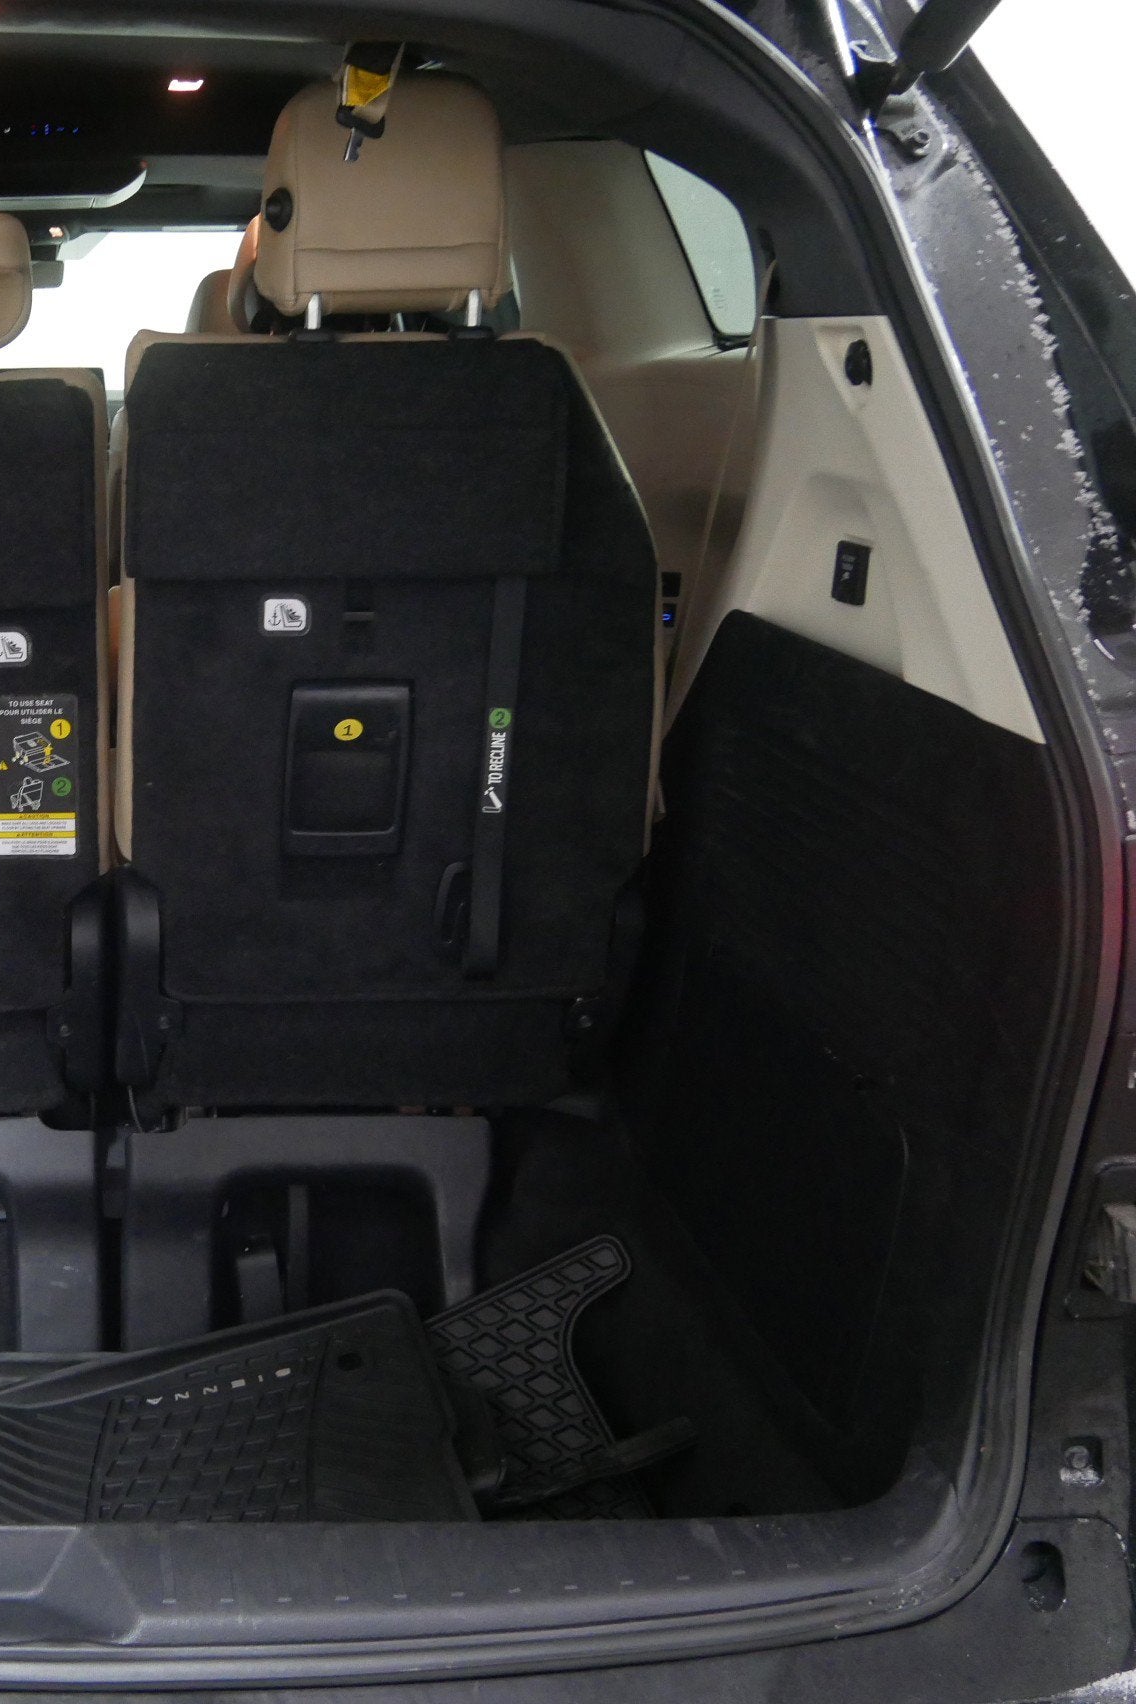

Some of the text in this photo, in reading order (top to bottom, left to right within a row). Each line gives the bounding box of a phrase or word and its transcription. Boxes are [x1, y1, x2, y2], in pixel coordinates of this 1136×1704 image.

[487, 732, 506, 784] TO RECLINE
[146, 1367, 291, 1405] SIENNA
